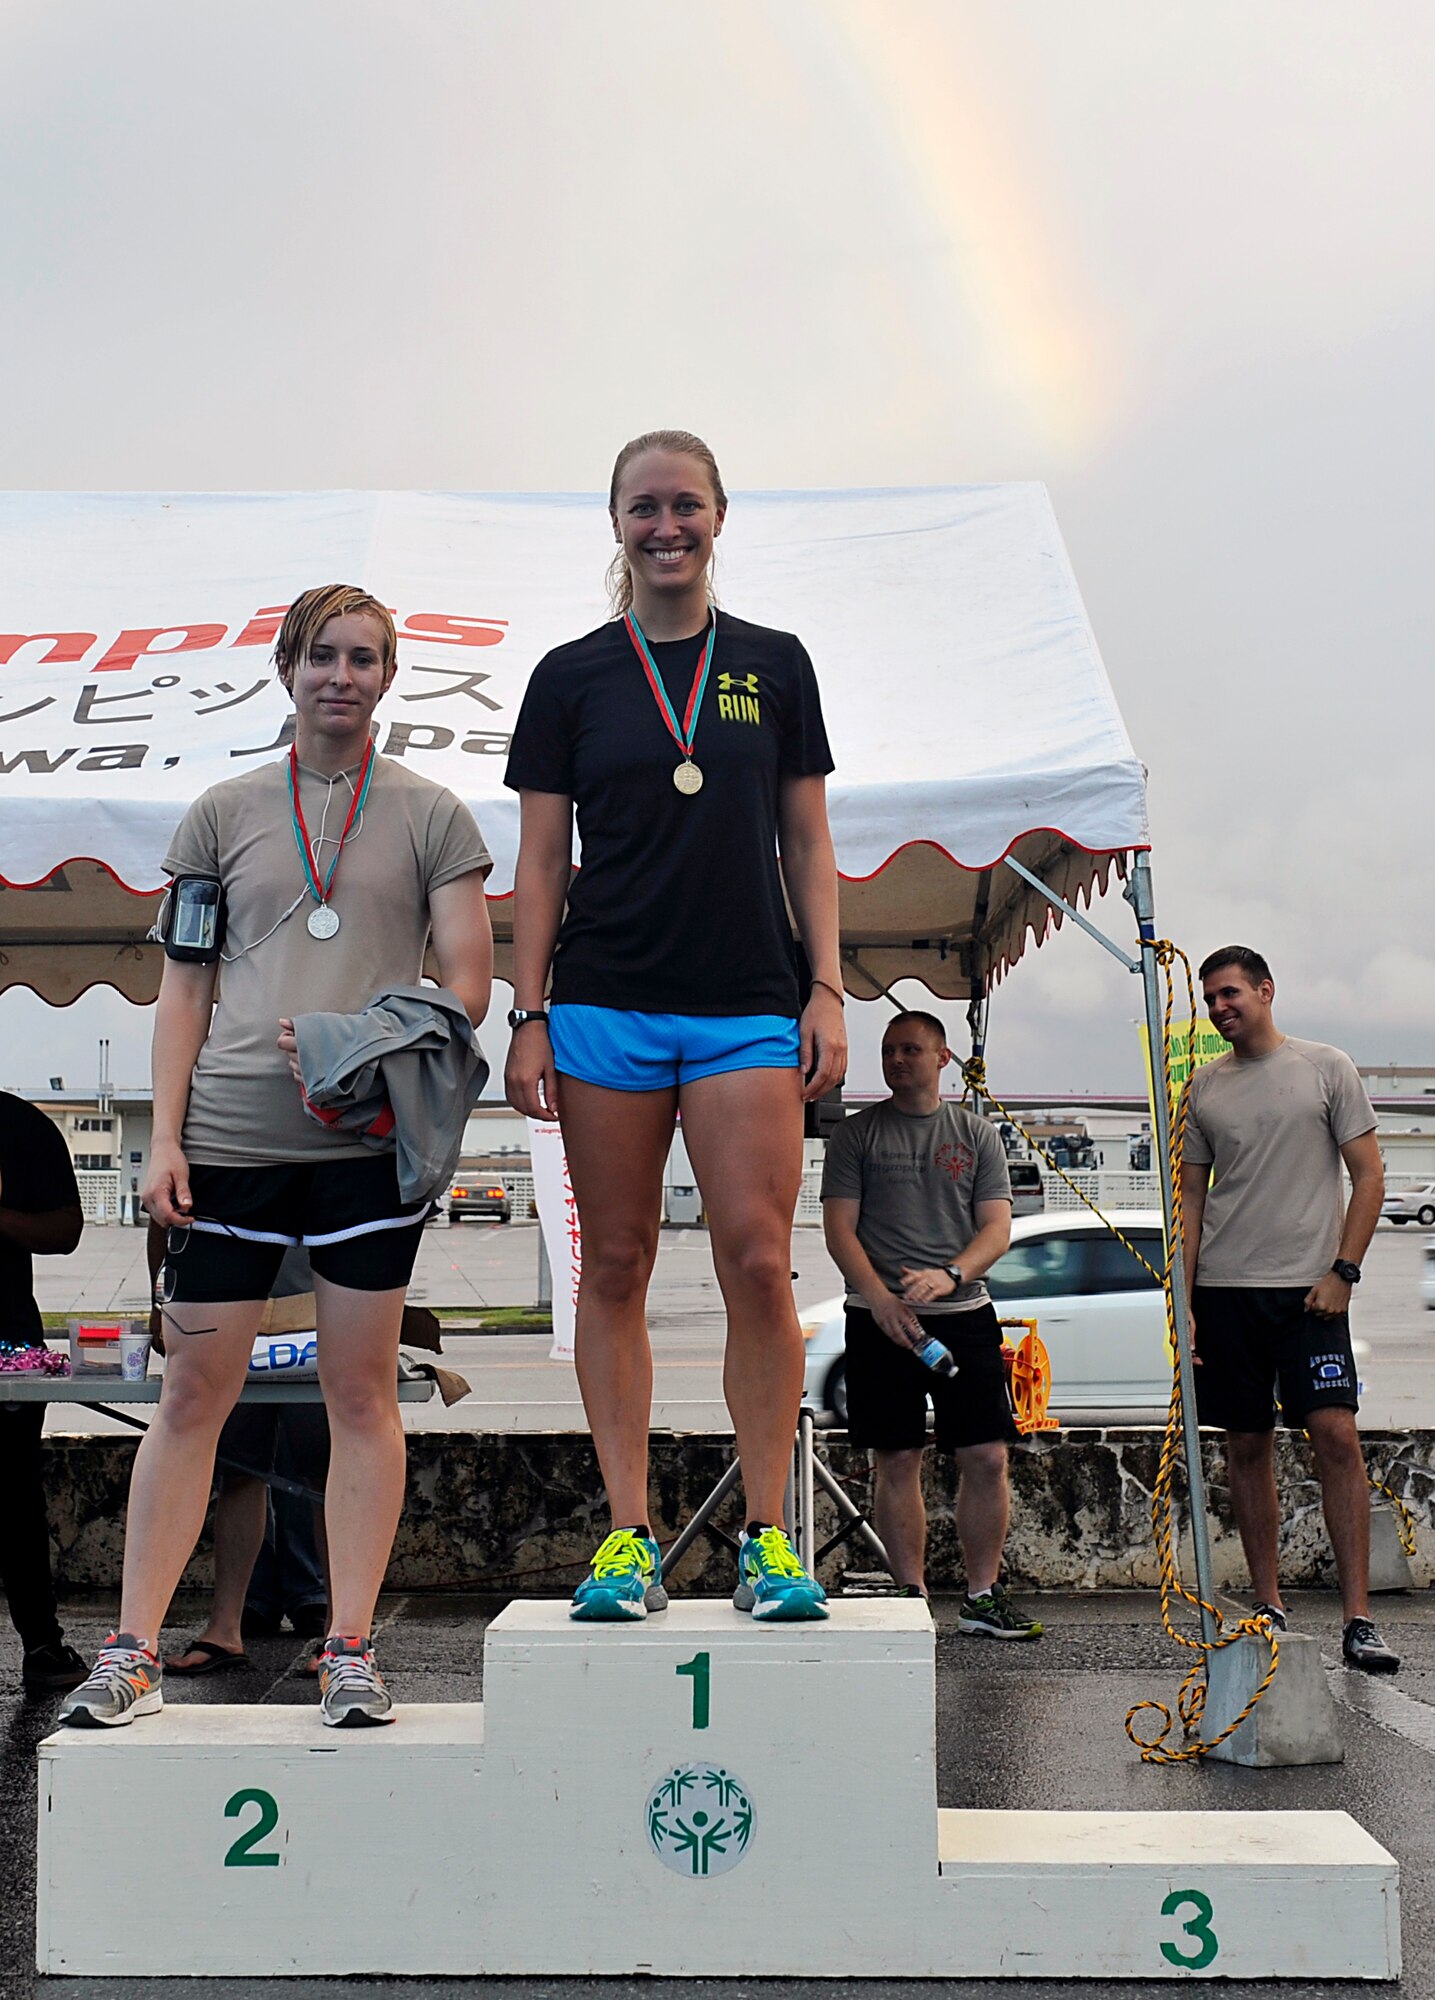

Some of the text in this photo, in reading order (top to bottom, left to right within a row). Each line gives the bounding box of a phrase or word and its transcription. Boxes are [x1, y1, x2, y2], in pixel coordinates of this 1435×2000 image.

[0, 604, 509, 673] pis
[0, 665, 504, 724] ンピッス
[718, 694, 760, 726] RUN
[675, 1652, 710, 1730] 1
[224, 1788, 280, 1867] 2
[1160, 1890, 1219, 1970] 3
